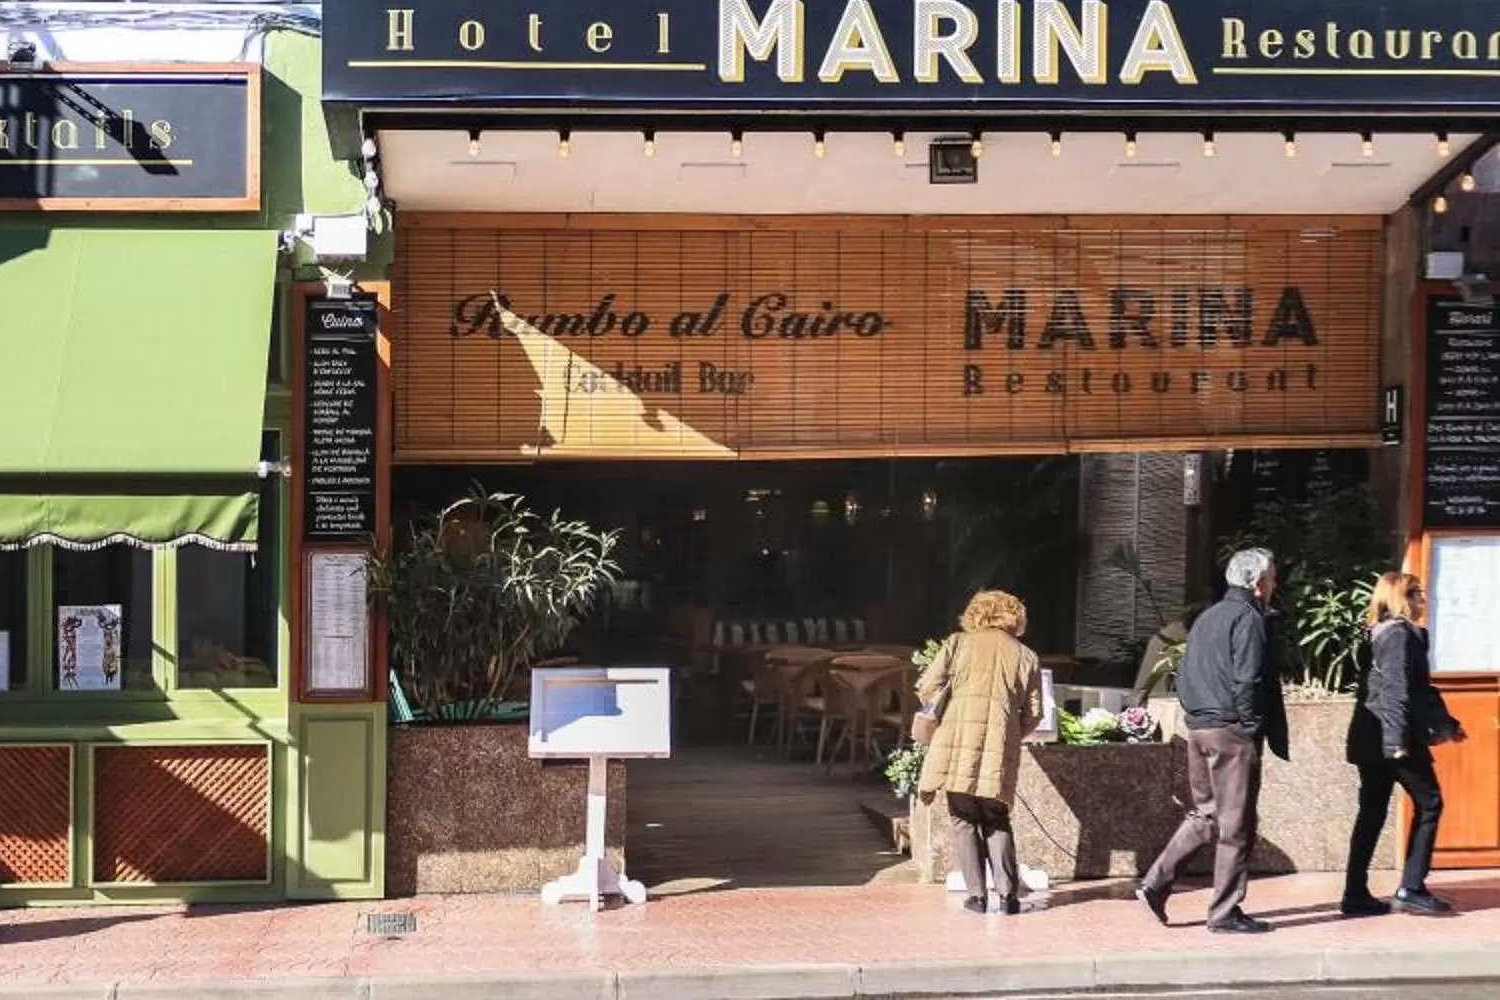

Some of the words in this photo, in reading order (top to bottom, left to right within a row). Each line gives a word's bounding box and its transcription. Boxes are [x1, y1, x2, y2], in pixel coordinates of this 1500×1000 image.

[385, 8, 672, 55] Hotel
[450, 289, 652, 340] Rumbo
[668, 293, 731, 340] al
[739, 293, 894, 340] Cairo
[963, 286, 1319, 350] MARINA
[564, 359, 681, 394] Cocktail
[699, 359, 755, 394] Bar
[963, 363, 1319, 398] Restaurant
